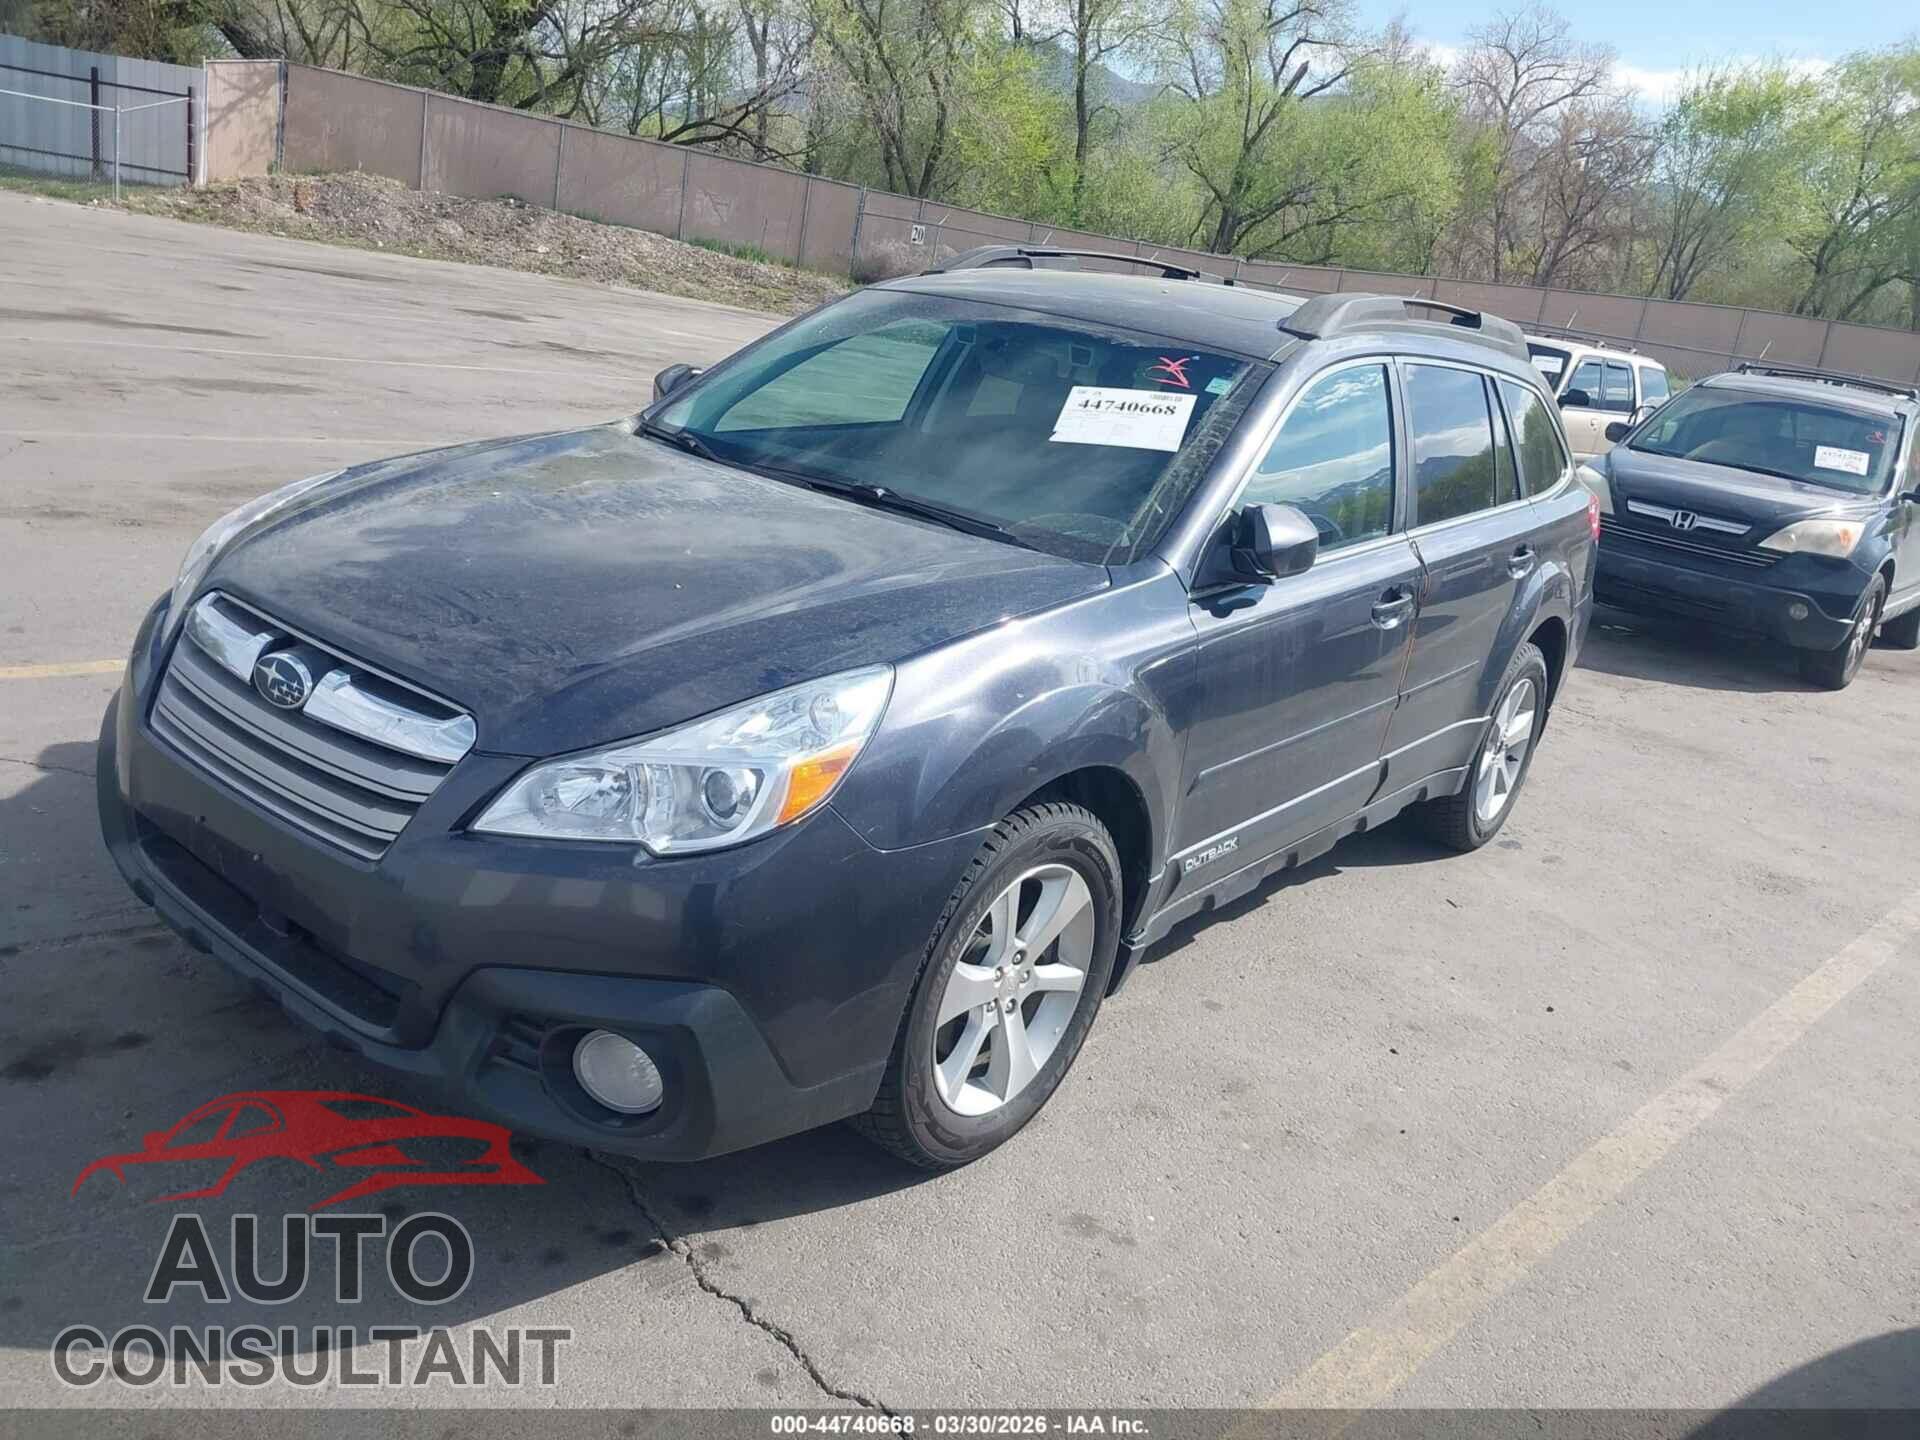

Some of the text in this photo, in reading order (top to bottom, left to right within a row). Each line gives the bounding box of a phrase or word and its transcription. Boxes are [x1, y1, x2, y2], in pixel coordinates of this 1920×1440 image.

[912, 226, 924, 241] 20
[1078, 398, 1177, 416] 44740668
[1184, 836, 1238, 869] OUTBACK
